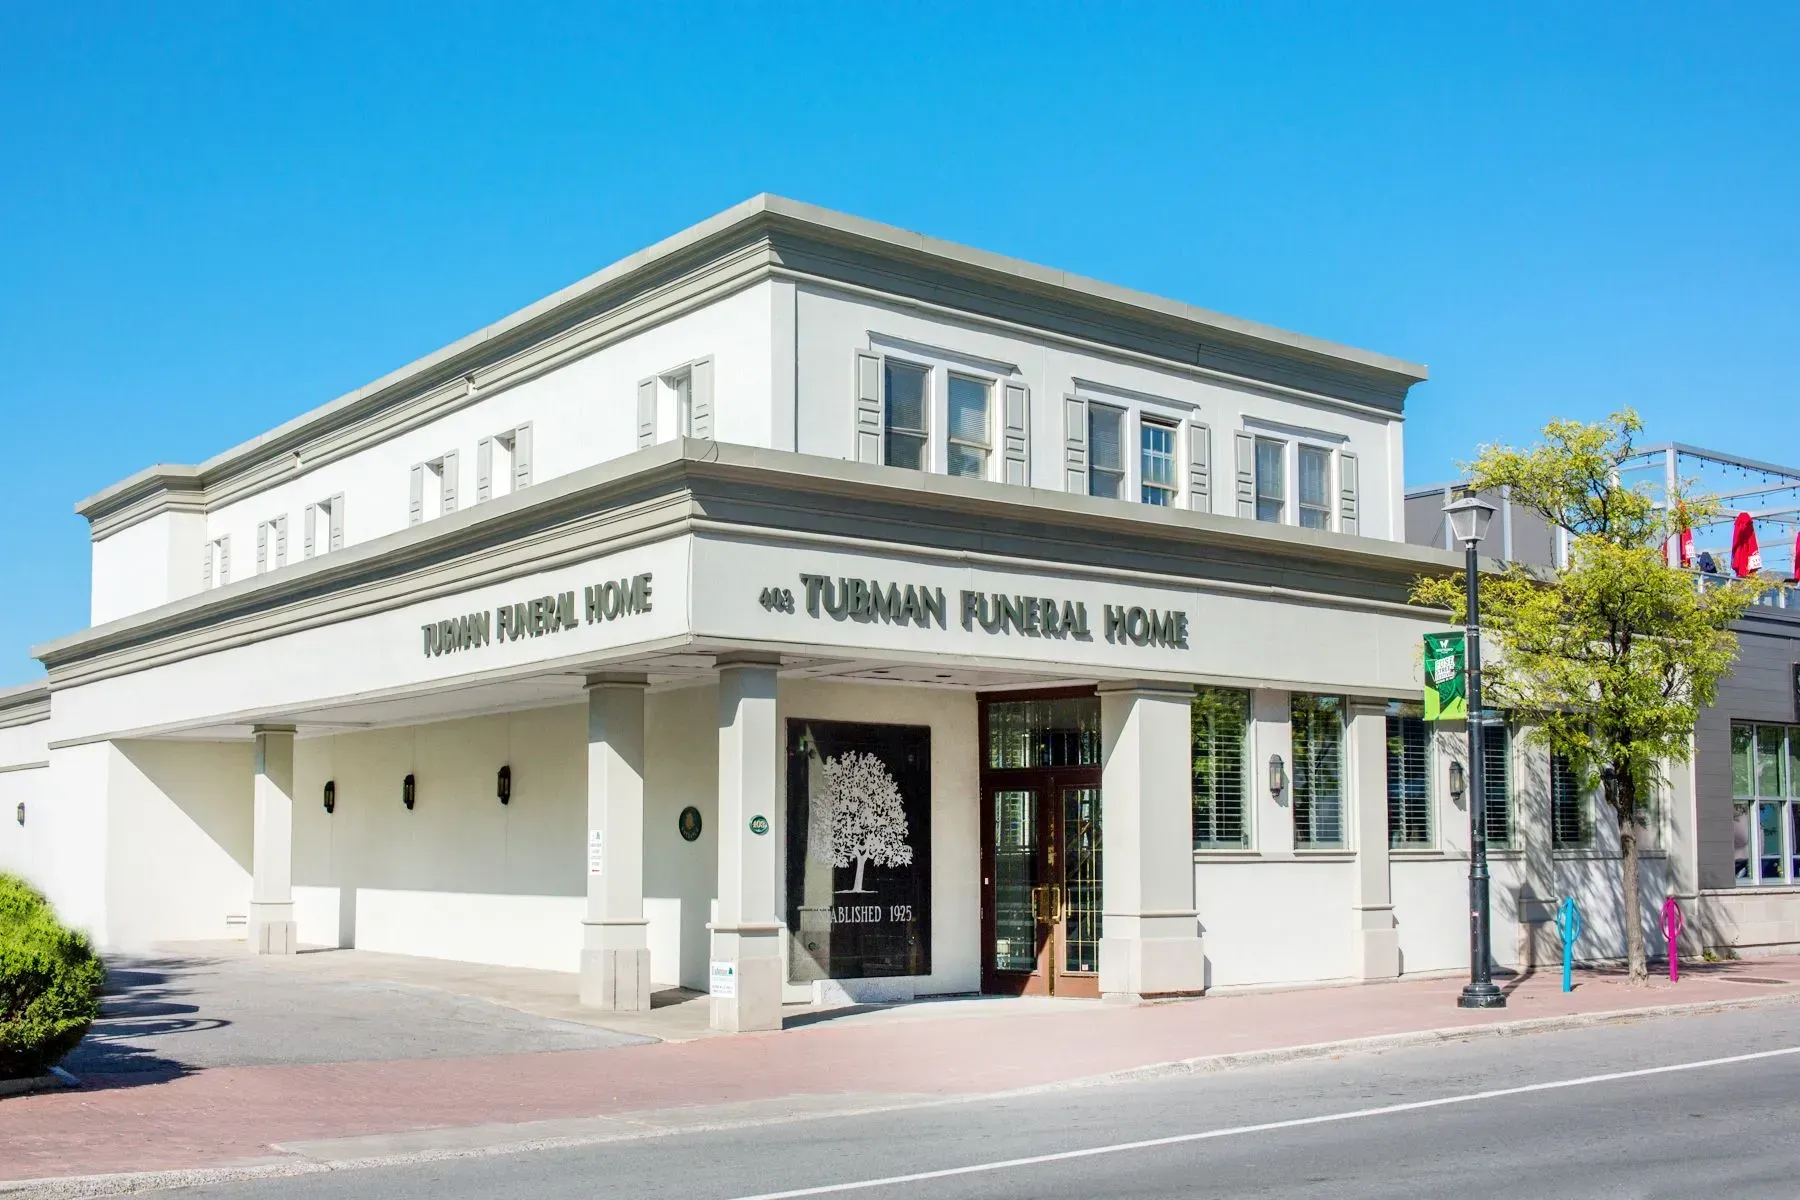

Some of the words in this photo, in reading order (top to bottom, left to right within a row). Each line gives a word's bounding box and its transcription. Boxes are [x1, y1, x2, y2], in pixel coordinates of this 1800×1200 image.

[421, 611, 490, 657] TUBMAN
[496, 591, 579, 642] FUNERAL
[584, 572, 653, 625] HOME
[759, 587, 793, 610] 403
[800, 573, 944, 628] TUBMAN
[960, 590, 1092, 639] FUNERAL
[1104, 604, 1187, 647] HOME
[811, 905, 882, 923] ABLISHED
[889, 905, 912, 922] 1925
